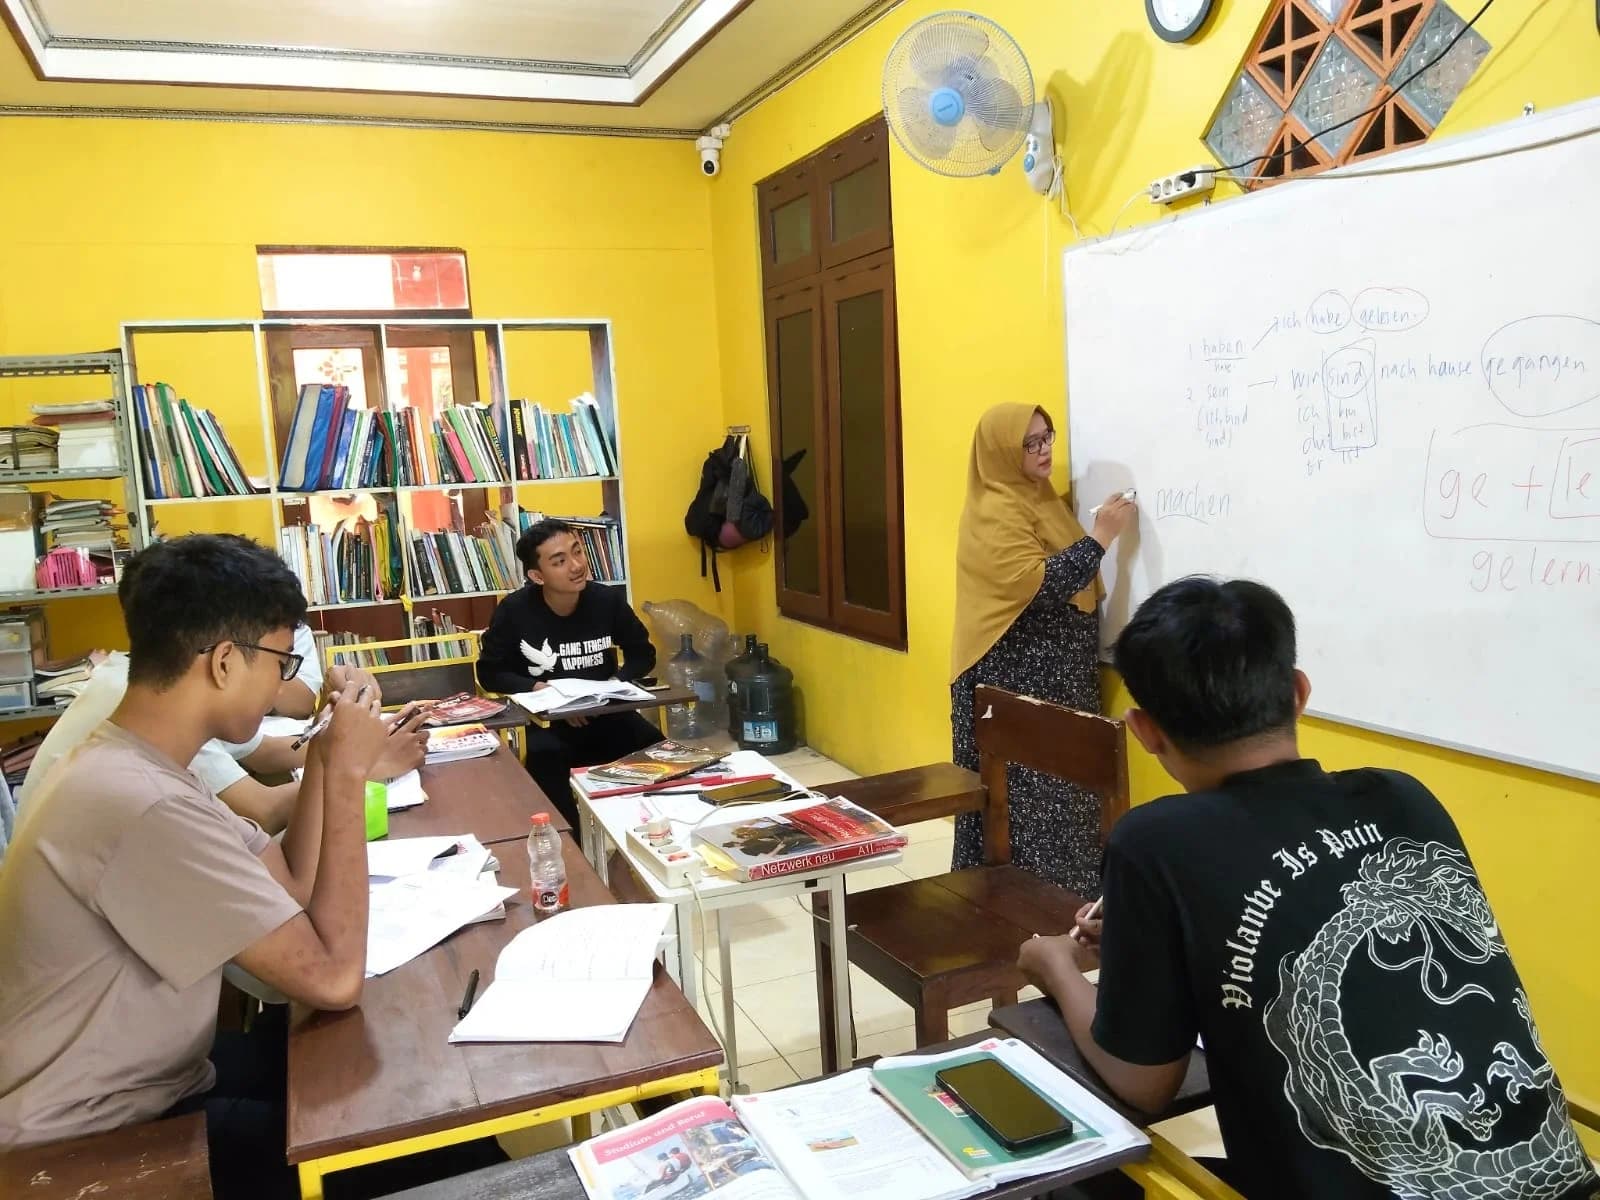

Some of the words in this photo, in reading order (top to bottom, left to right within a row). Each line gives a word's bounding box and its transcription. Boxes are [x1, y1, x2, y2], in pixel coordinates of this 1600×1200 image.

[1311, 307, 1343, 328] habe
[1201, 337, 1245, 355] haben
[1327, 361, 1366, 386] sind
[1381, 359, 1417, 379] nach
[1428, 353, 1473, 378] hause
[1156, 479, 1231, 521] machen
[1439, 469, 1489, 520] ge
[559, 641, 582, 656] GANG
[761, 855, 812, 876] Netzwerk
[814, 851, 836, 864] neu
[1271, 841, 1319, 880] Is
[1315, 819, 1384, 859] Pain
